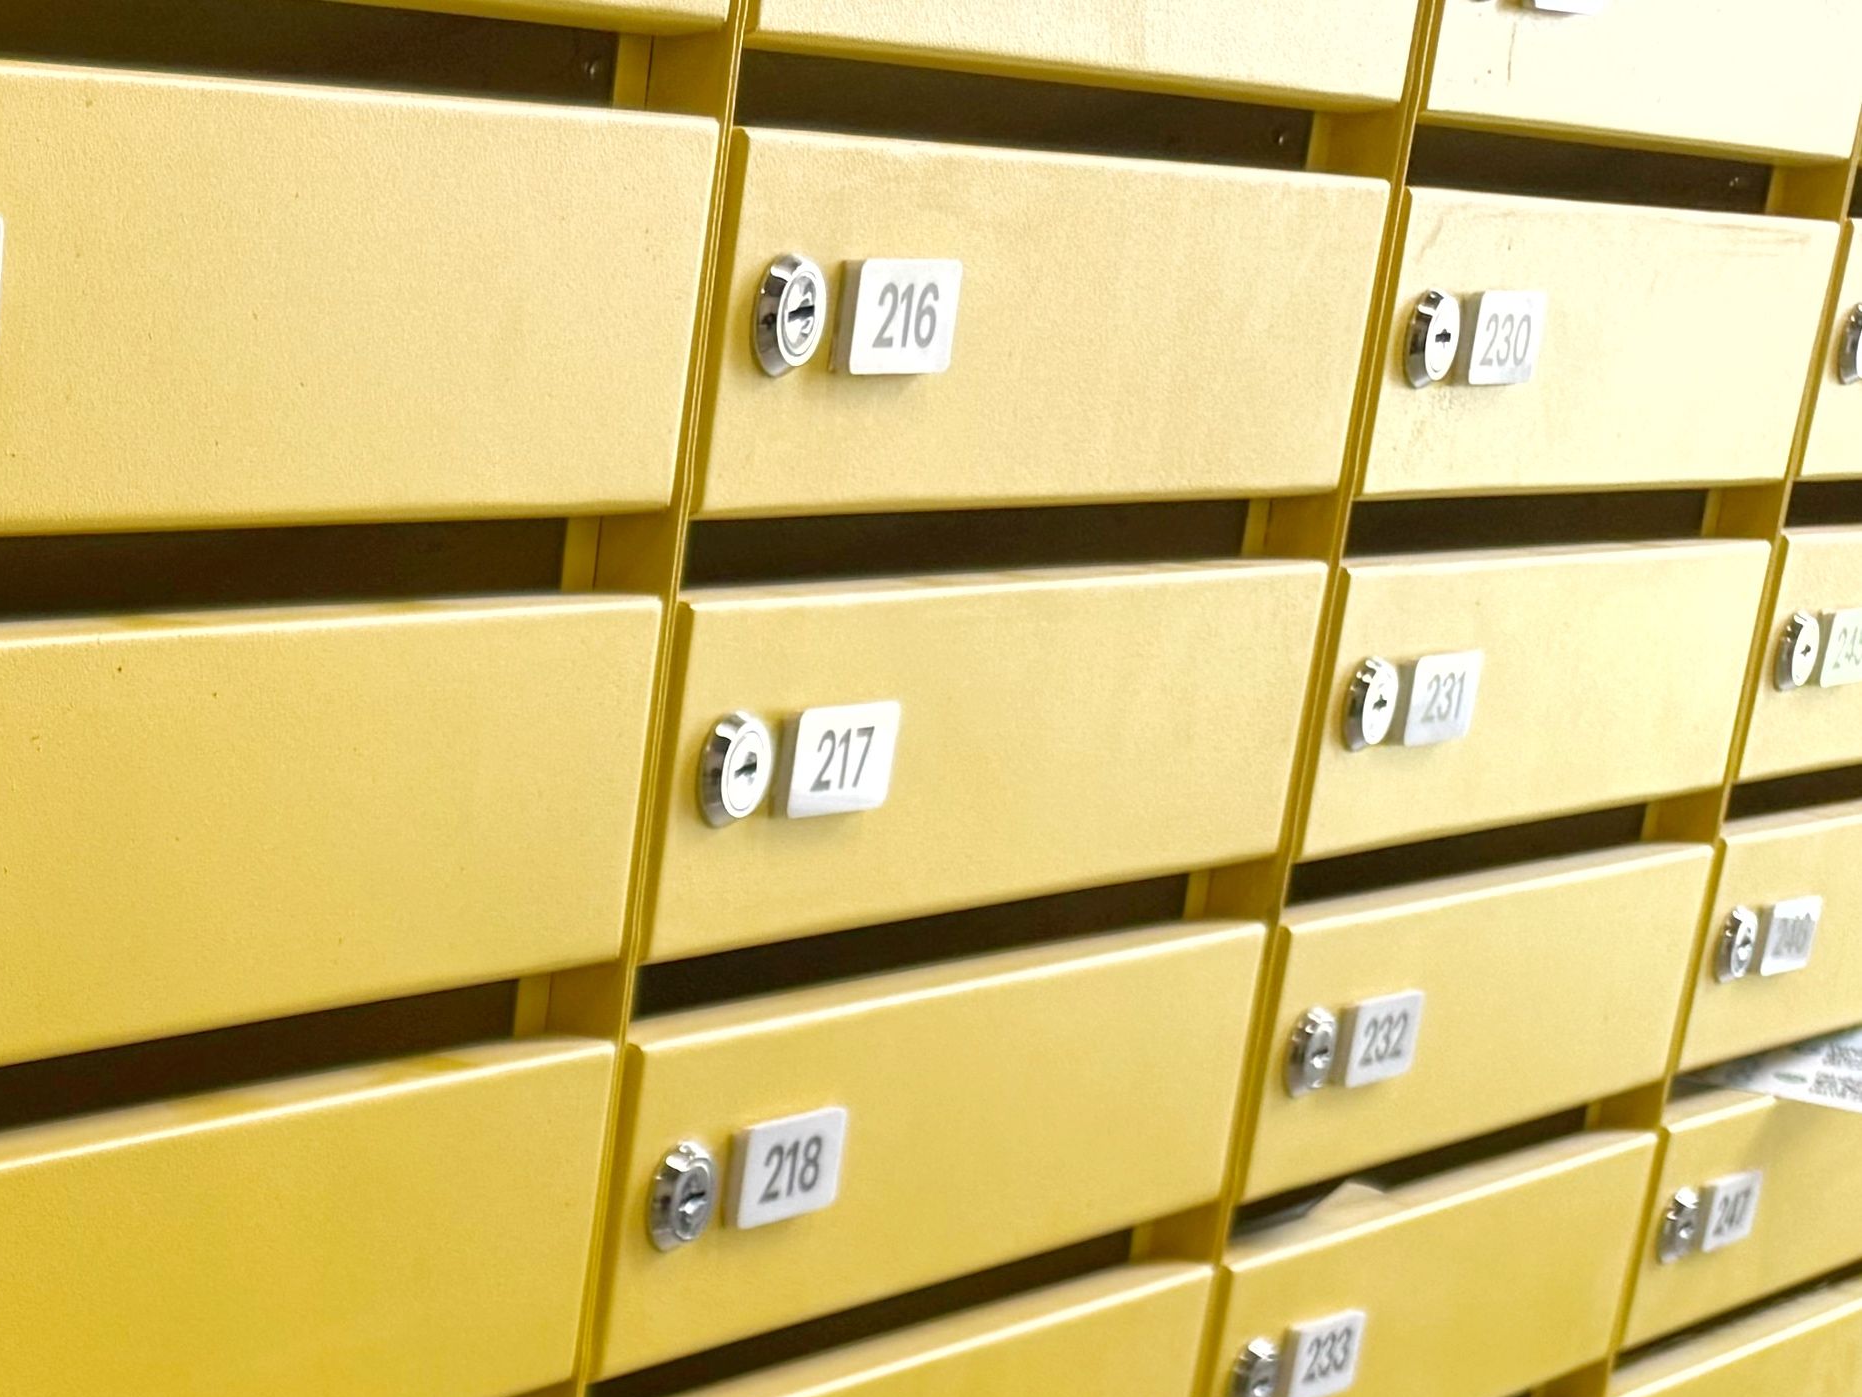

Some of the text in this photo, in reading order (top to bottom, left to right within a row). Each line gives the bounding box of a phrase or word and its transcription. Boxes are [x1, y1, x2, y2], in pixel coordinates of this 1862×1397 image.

[872, 282, 939, 348] 216
[1479, 313, 1531, 367] 230
[1422, 671, 1465, 725] 231
[810, 726, 875, 792] 217
[1358, 1009, 1409, 1067] 232
[759, 1135, 823, 1203] 218
[1301, 1326, 1354, 1383] 233
